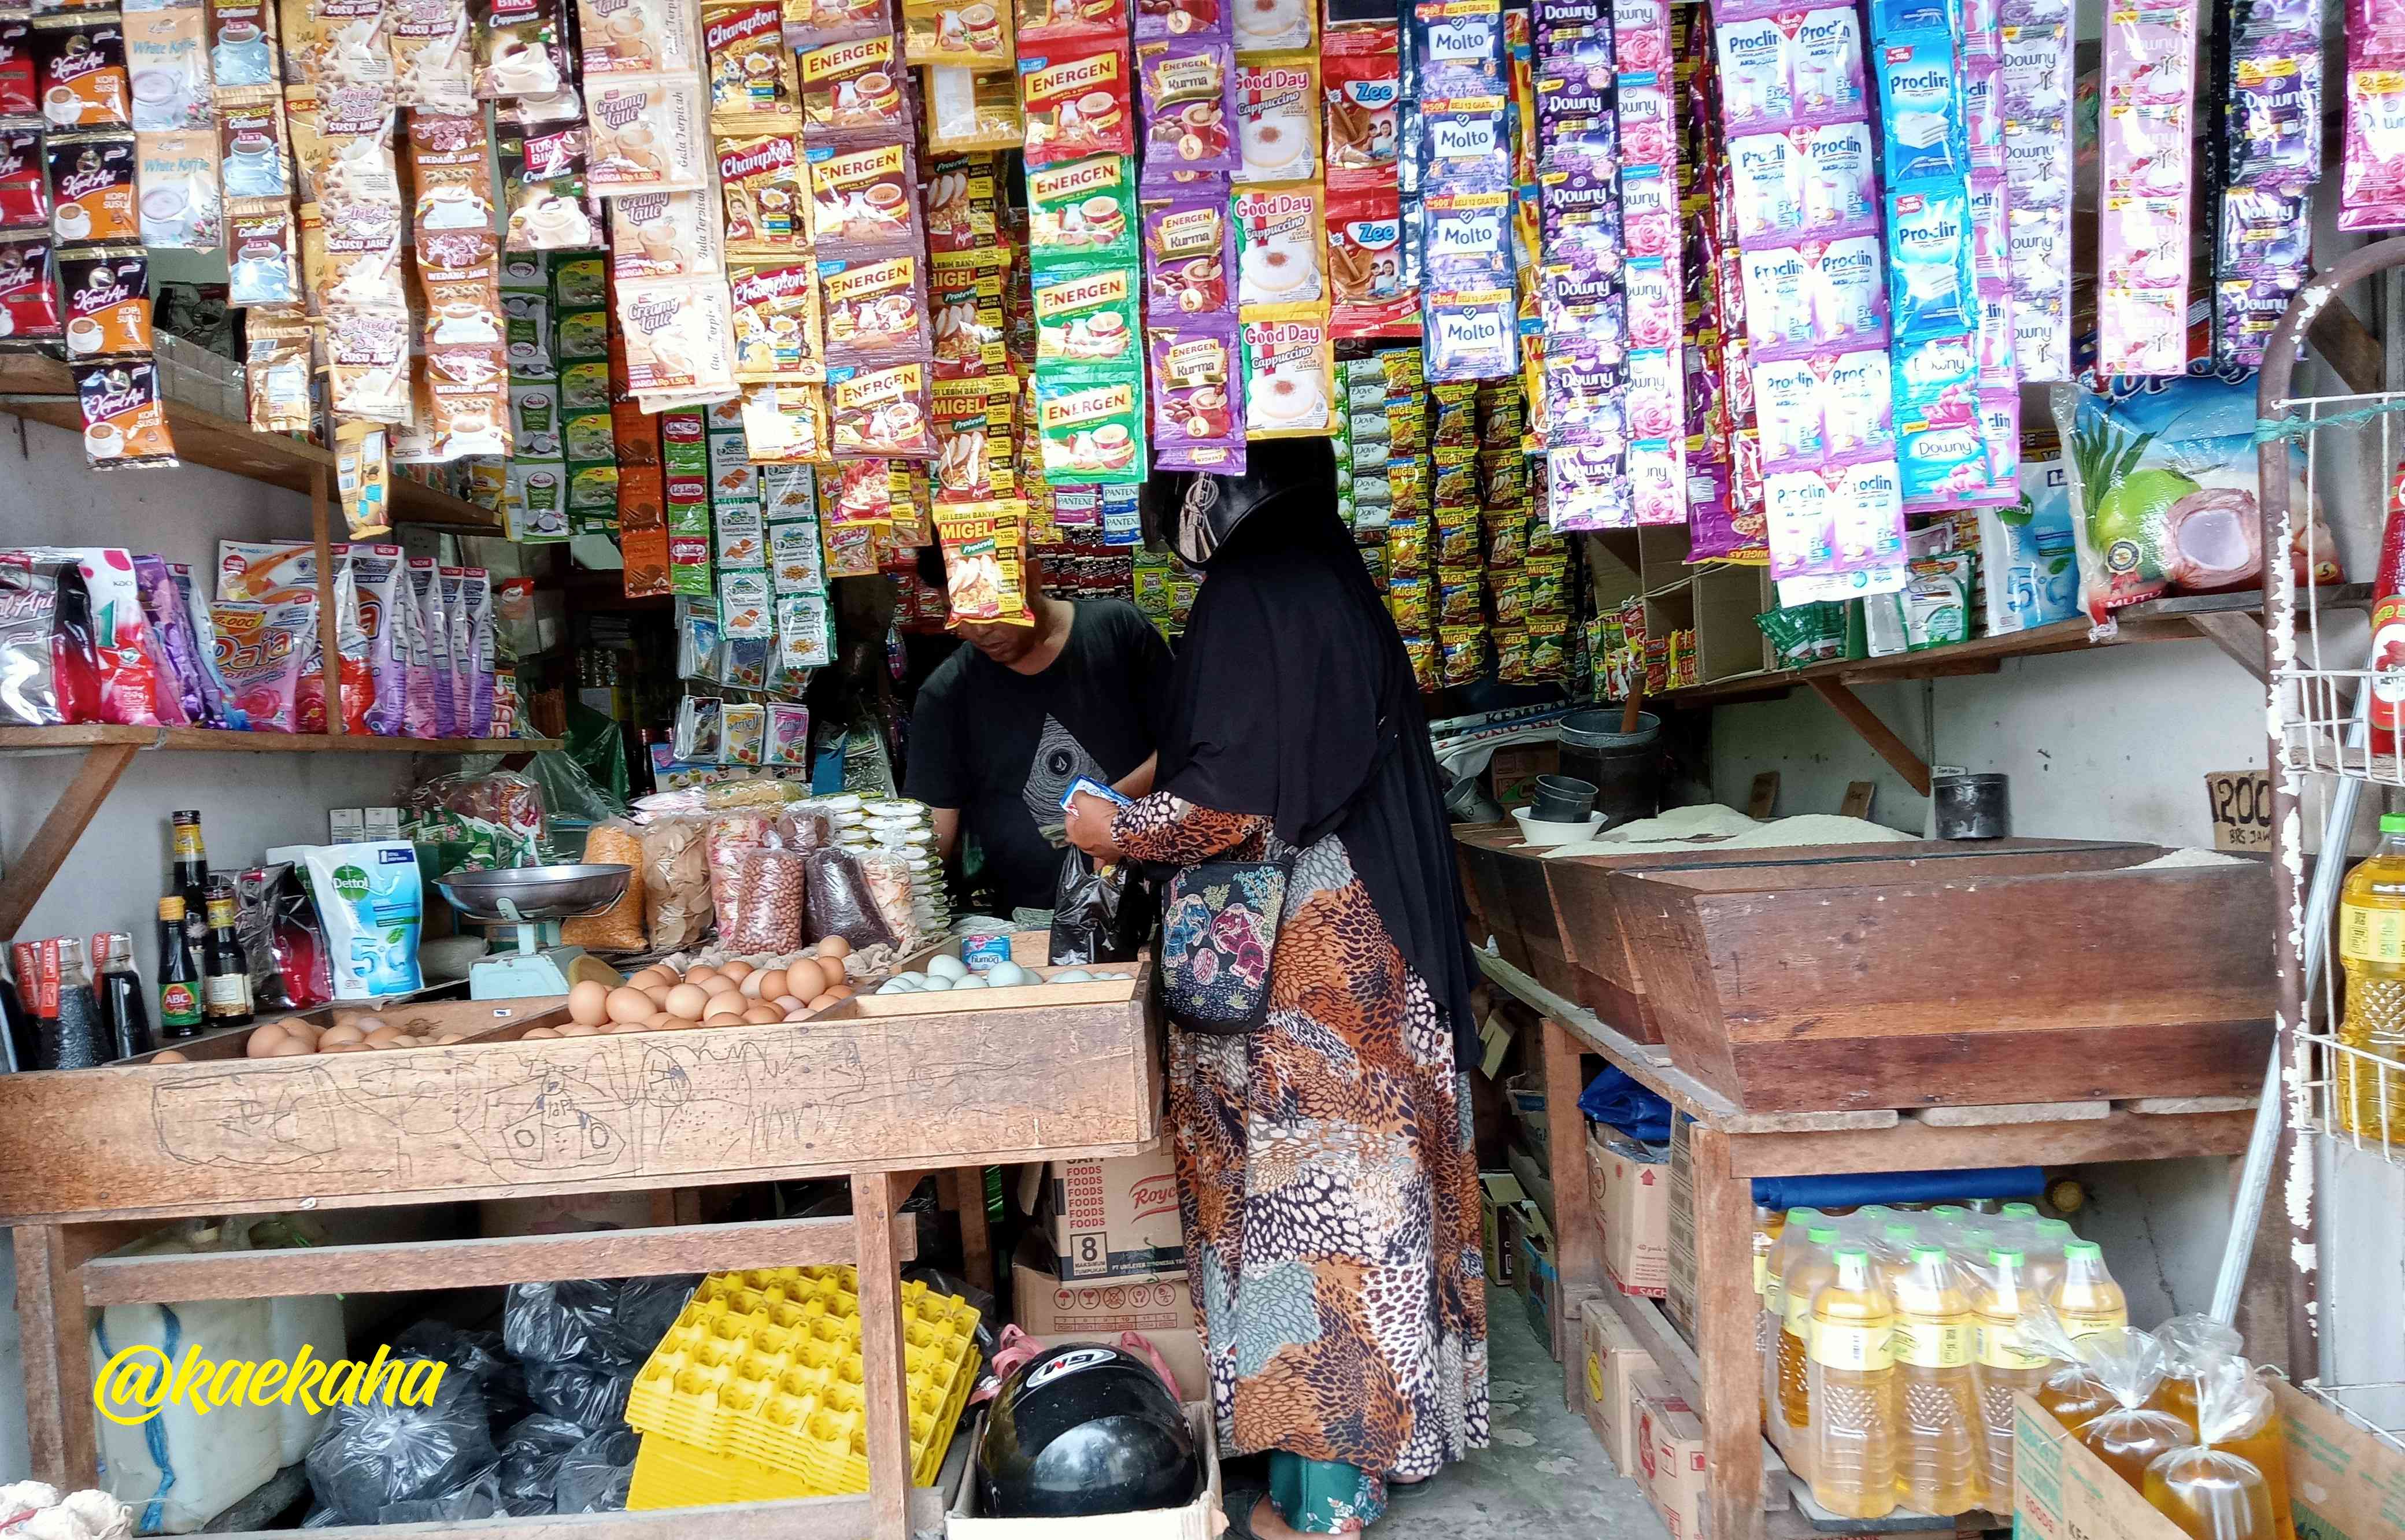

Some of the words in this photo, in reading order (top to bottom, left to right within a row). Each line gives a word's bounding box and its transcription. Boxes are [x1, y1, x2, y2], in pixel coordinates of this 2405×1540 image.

[324, 4, 350, 16] SUSU
[351, 2, 380, 14] JAHE
[1544, 4, 1597, 22] Downy
[399, 25, 433, 36] SUSU
[434, 22, 457, 34] JAHE
[706, 9, 778, 47] Champion
[132, 39, 165, 54] White
[1436, 34, 1484, 51] Molto
[809, 40, 888, 73] ENERGEN
[1163, 58, 1207, 72] ENERGEN
[2003, 51, 2056, 69] Downy
[95, 76, 117, 85] KOPI
[1033, 61, 1111, 93] ENERGEN
[1168, 74, 1208, 88] Kurma
[1276, 69, 1308, 90] Day
[1890, 74, 1949, 95] Proclin
[94, 84, 119, 93] SUSU
[1356, 82, 1393, 101] Zee
[594, 92, 646, 114] Creamy
[1237, 90, 1300, 116] Cappuccino
[1550, 94, 1602, 113] Downy
[2246, 88, 2307, 112] Downy
[605, 108, 639, 130] Latte
[672, 91, 687, 139] Terpisah
[328, 122, 352, 134] SUSU
[353, 119, 382, 132] JAHE
[1441, 130, 1488, 148] Molto
[1812, 136, 1862, 158] Proclin
[456, 152, 481, 162] JAHE
[676, 139, 689, 168] Gula
[720, 139, 793, 176] Champion
[2004, 143, 2056, 162] Downy
[143, 158, 176, 173] White
[819, 152, 897, 183] ENERGEN
[1037, 164, 1115, 194] ENERGEN
[105, 192, 127, 202] KOPI
[1477, 197, 1500, 206] GRATIS
[1555, 186, 1607, 206] Downy
[629, 205, 661, 225] Latte
[1236, 198, 1276, 219] Good
[1280, 195, 1313, 216] Day
[1166, 212, 1211, 229] ENERGEN
[1245, 216, 1305, 240] Cappuccino
[1170, 232, 1210, 249] Kurma
[1359, 223, 1395, 243] Zee
[1445, 227, 1492, 245] Molto
[335, 239, 362, 250] SUSU
[362, 237, 390, 249] JAHE
[1822, 250, 1873, 272] Proclin
[427, 271, 463, 282] WEDANG
[464, 268, 489, 280] JAHE
[831, 264, 909, 294] ENERGEN
[733, 268, 806, 303] Champion
[1044, 280, 1122, 308] ENERGEN
[1558, 278, 1610, 298] Downy
[1480, 292, 1503, 302] GRATIS
[2236, 297, 2288, 314] Downy
[118, 306, 140, 315] KOPI
[628, 298, 679, 320] Creamy
[116, 314, 140, 323] SUSU
[639, 313, 672, 335] Latte
[1244, 326, 1285, 346] Good
[1288, 324, 1320, 345] Day
[1448, 323, 1495, 341] Molto
[340, 352, 368, 364] SUSU
[1172, 341, 1217, 358] ENERGEN
[1252, 345, 1312, 369] Cappuccino
[1176, 360, 1215, 376] Kurma
[630, 377, 658, 389] HARGA
[658, 376, 669, 387] Rp
[1562, 369, 1614, 389] Downy
[942, 388, 963, 396] LEBIH
[1351, 387, 1374, 395] Dove
[136, 418, 160, 428] SUSU
[1353, 416, 1375, 425] Dove
[1355, 445, 1378, 455] Dove
[1918, 440, 1973, 458] Downy
[1355, 479, 1377, 487] Dove
[1057, 495, 1094, 507] PANTENE
[1356, 507, 1379, 518] Dove
[377, 546, 395, 554] NEW
[2321, 562, 2332, 578] 5
[1141, 578, 1162, 588] Racik
[1529, 620, 1565, 634] MIGELAS
[333, 876, 369, 889] Dettol
[165, 993, 188, 1005] ABC
[1067, 1165, 1102, 1176] FOODS
[1067, 1176, 1102, 1187] FOODS
[1068, 1186, 1103, 1197] FOODS
[1069, 1197, 1104, 1208] FOODS
[1070, 1207, 1105, 1218] FOODS
[1070, 1217, 1105, 1229] FOODS
[1082, 1237, 1098, 1261] 8
[1075, 1260, 1106, 1268] MAKSIMUM
